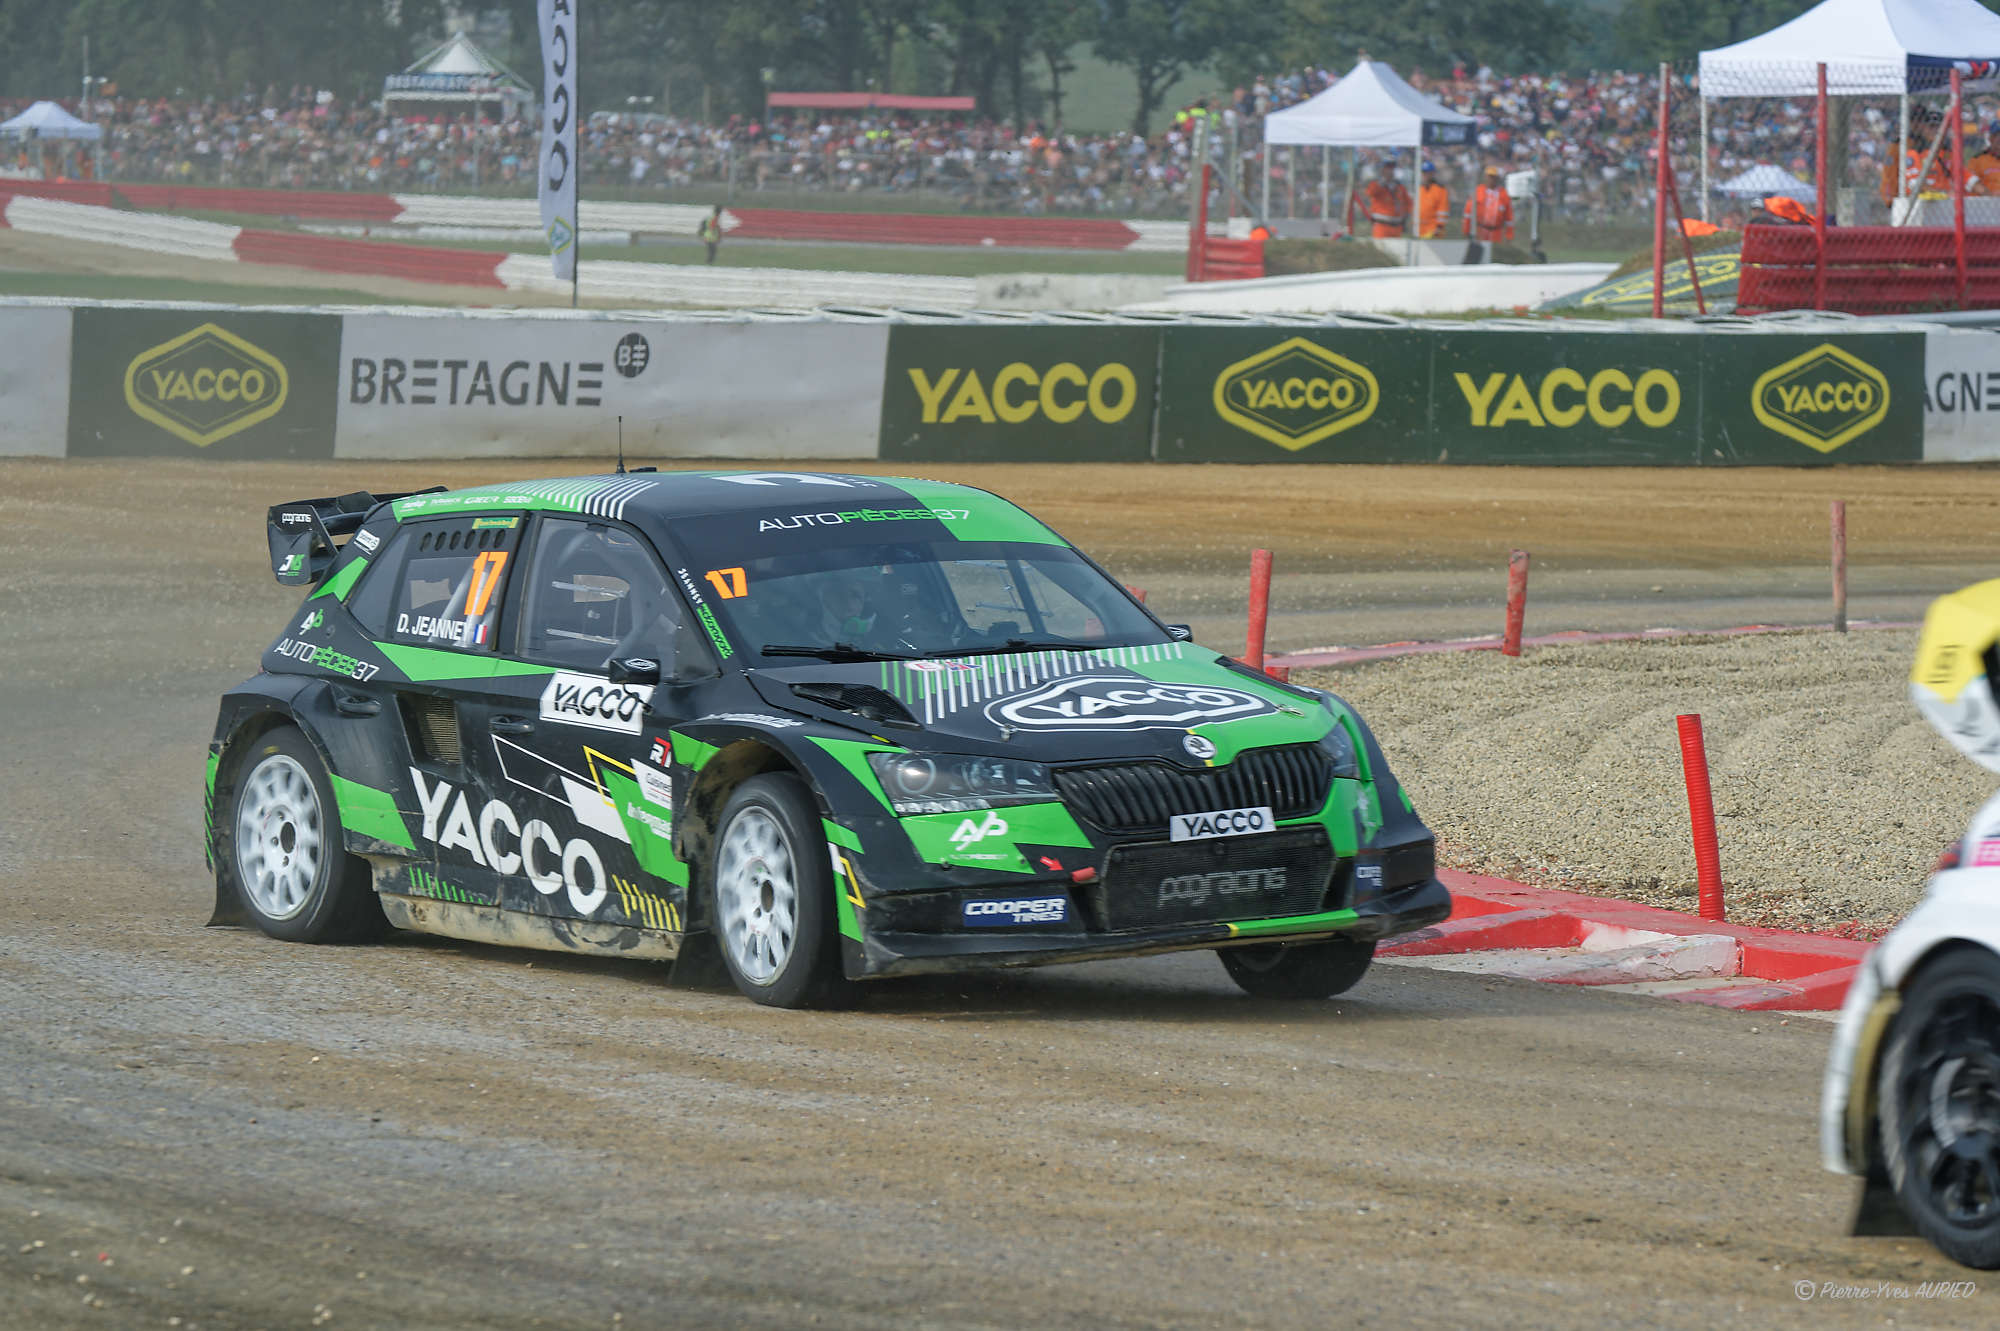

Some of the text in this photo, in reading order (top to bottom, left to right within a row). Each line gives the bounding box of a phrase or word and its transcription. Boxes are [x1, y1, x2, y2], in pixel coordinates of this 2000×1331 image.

[151, 367, 265, 403] YACCO
[350, 358, 603, 407] BRETAGNE
[908, 362, 1137, 424] YACCO
[1241, 378, 1355, 410] YACCO
[1454, 368, 1680, 428] YACCO
[1776, 381, 1873, 413] YACCO
[759, 508, 970, 532] AUTOPIÈCES37
[464, 551, 509, 616] 17
[677, 568, 703, 604] JEANNEY
[704, 567, 748, 599] 17
[397, 613, 409, 633] D.
[554, 683, 640, 722] YACCO
[1029, 688, 1236, 717] YACCO
[1182, 810, 1264, 837] YACCO
[409, 766, 607, 915] YACCO
[965, 898, 1066, 916] COOPER
[1013, 911, 1064, 922] TIRES
